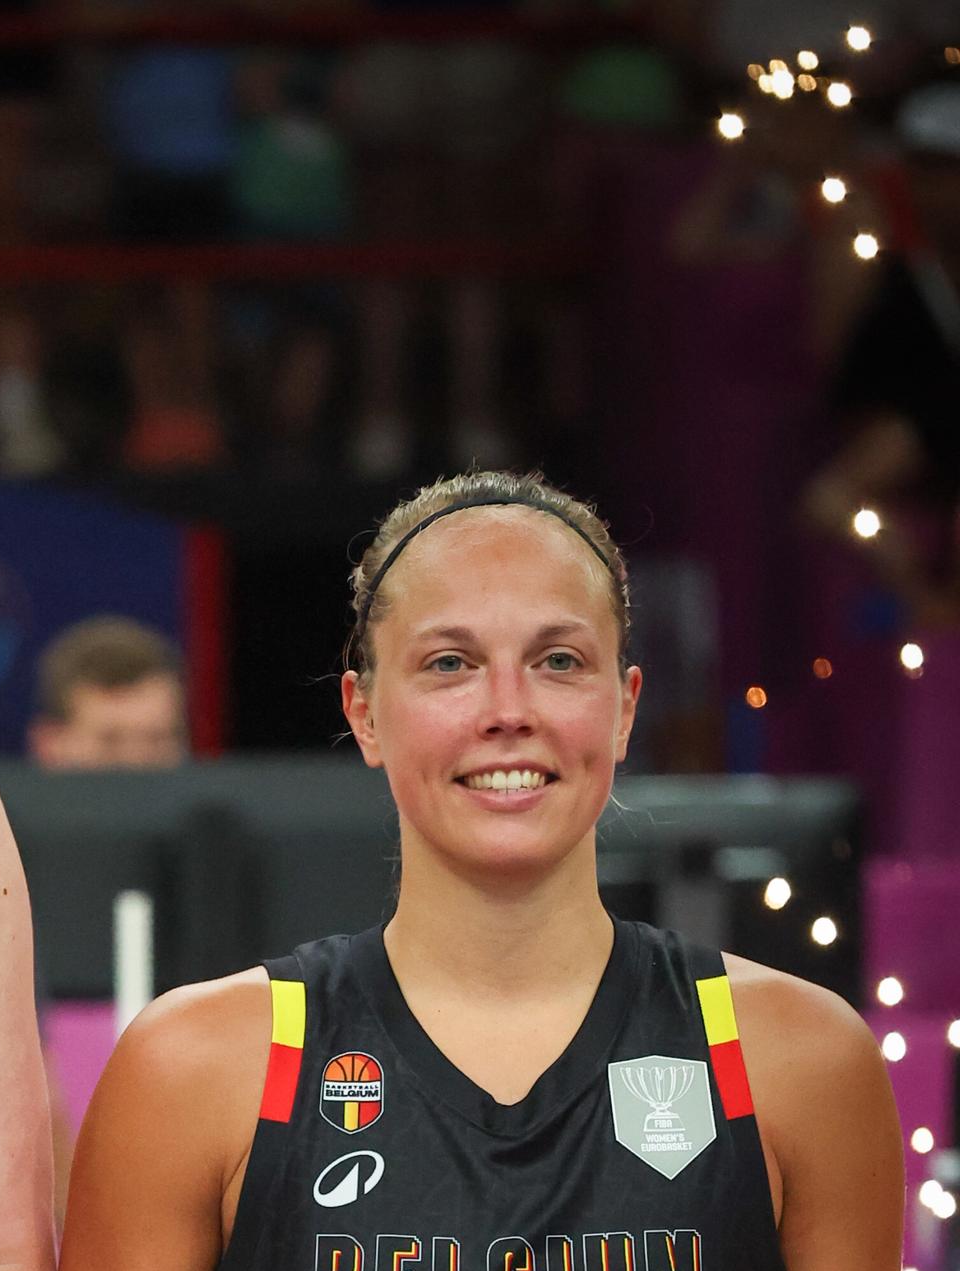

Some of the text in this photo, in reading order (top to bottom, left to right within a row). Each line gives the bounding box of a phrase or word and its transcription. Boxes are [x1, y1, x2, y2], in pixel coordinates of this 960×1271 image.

[325, 1090, 379, 1098] BELGIUM
[654, 1119, 672, 1128] FIBA
[645, 1133, 685, 1143] WOMEN'S
[641, 1142, 693, 1152] EUROBASKET
